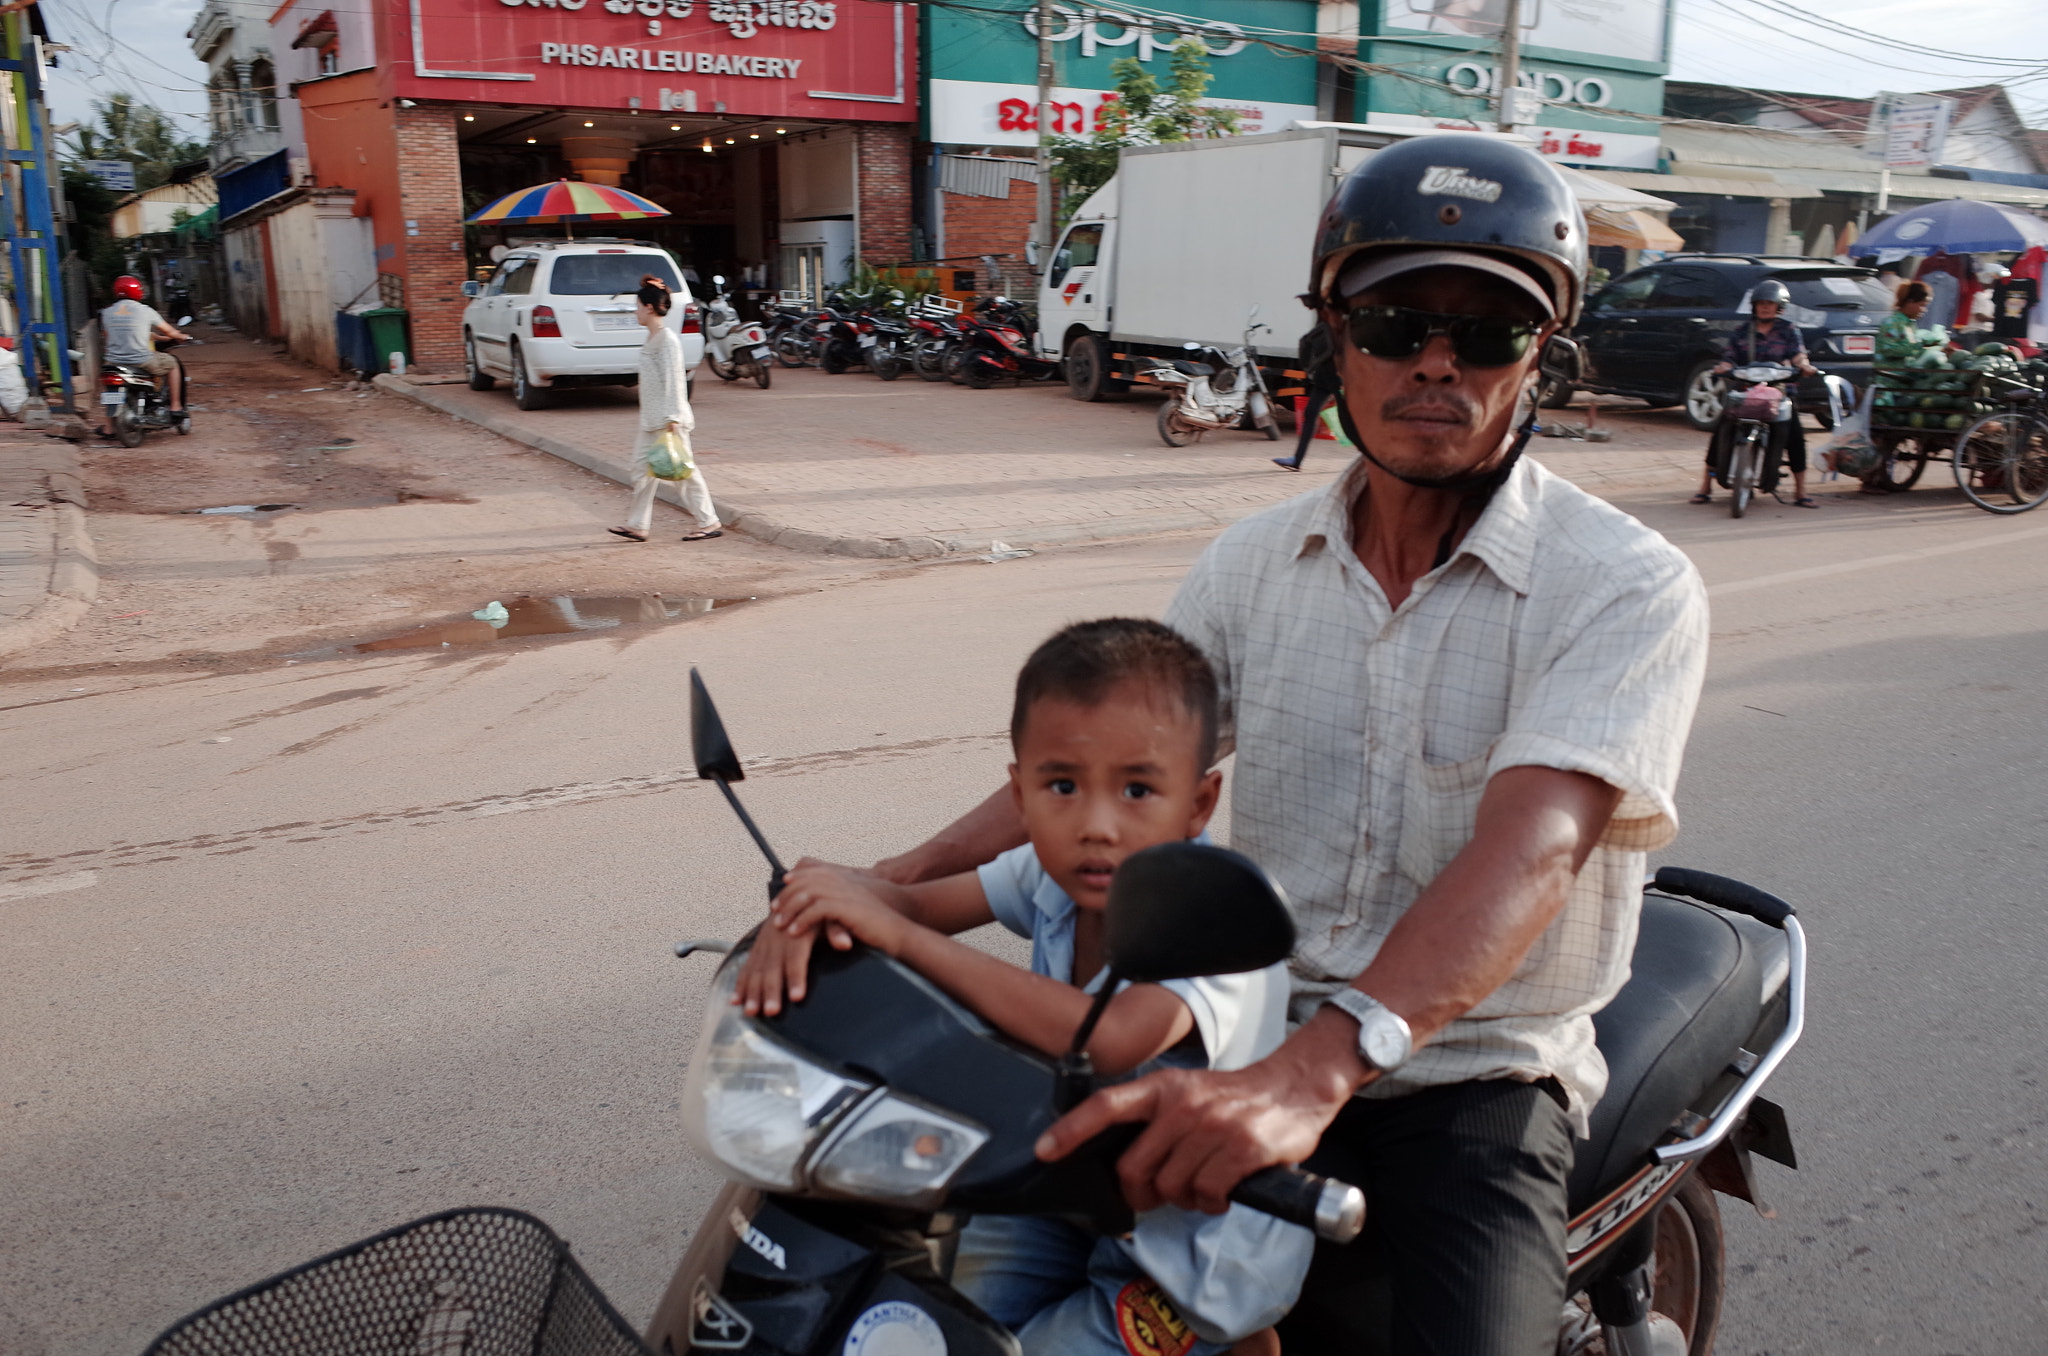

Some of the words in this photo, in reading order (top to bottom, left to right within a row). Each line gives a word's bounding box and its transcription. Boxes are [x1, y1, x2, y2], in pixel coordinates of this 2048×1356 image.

[541, 42, 639, 70] PHSAR
[642, 49, 694, 73] LEU
[696, 52, 802, 79] BAKERY
